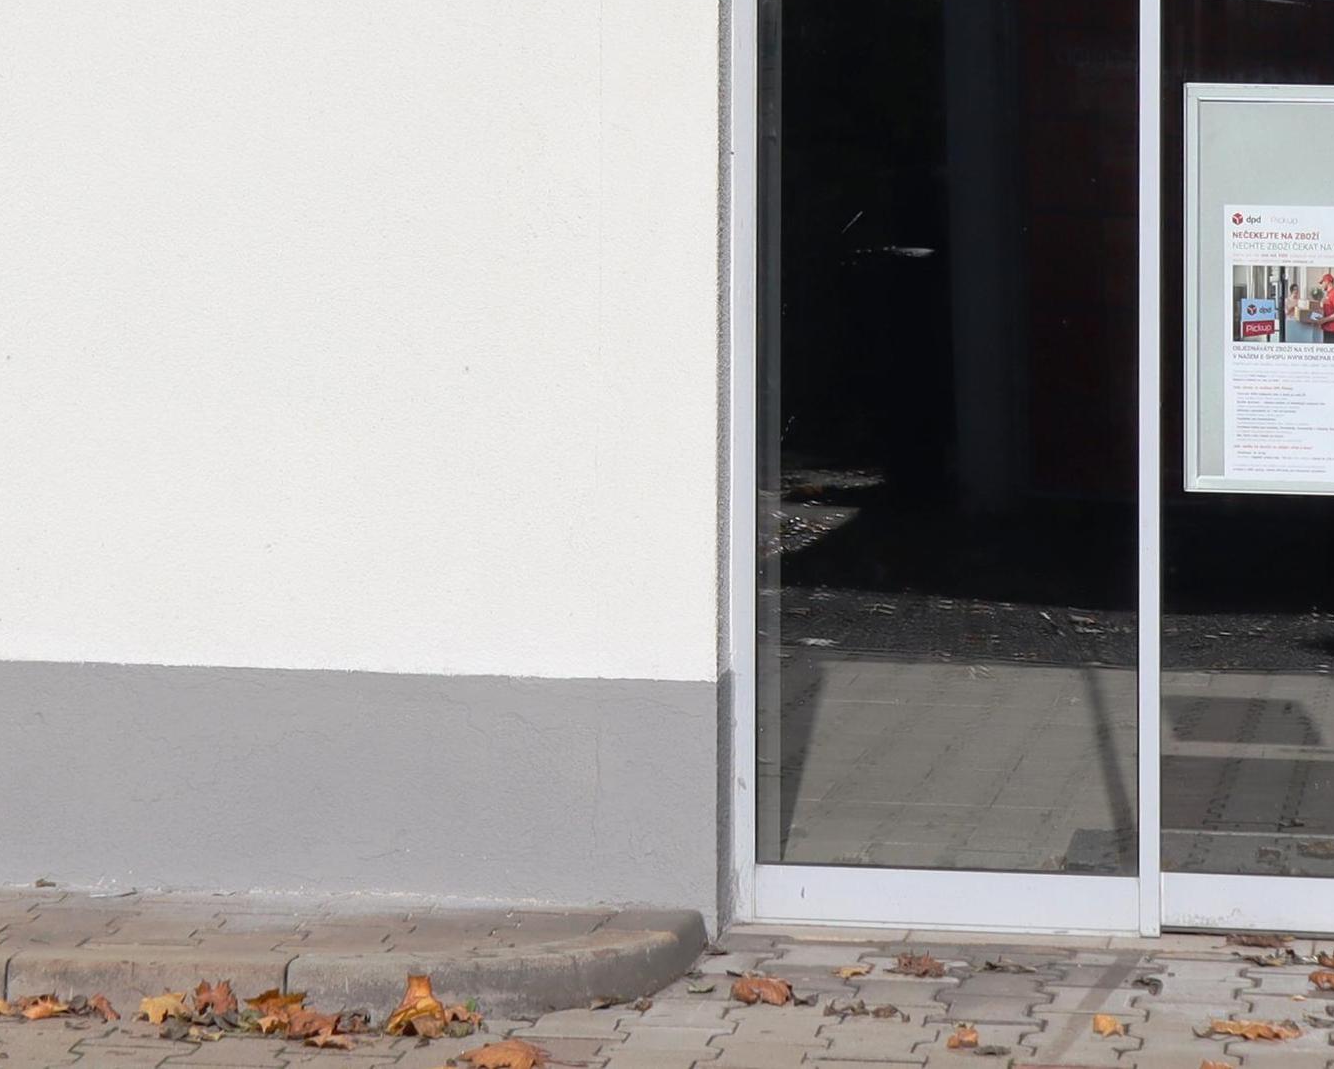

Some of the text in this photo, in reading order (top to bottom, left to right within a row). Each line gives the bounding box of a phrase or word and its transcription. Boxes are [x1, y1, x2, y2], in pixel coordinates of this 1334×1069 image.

[1246, 216, 1262, 224] dpd
[1232, 230, 1279, 240] NEČEKEJTE
[1295, 231, 1320, 241] ZBOŽÍ
[1232, 242, 1265, 250] NECHTE
[1267, 241, 1291, 250] ZBOŽÍ
[1293, 241, 1318, 251] ČEKAT
[1320, 243, 1332, 251] NA
